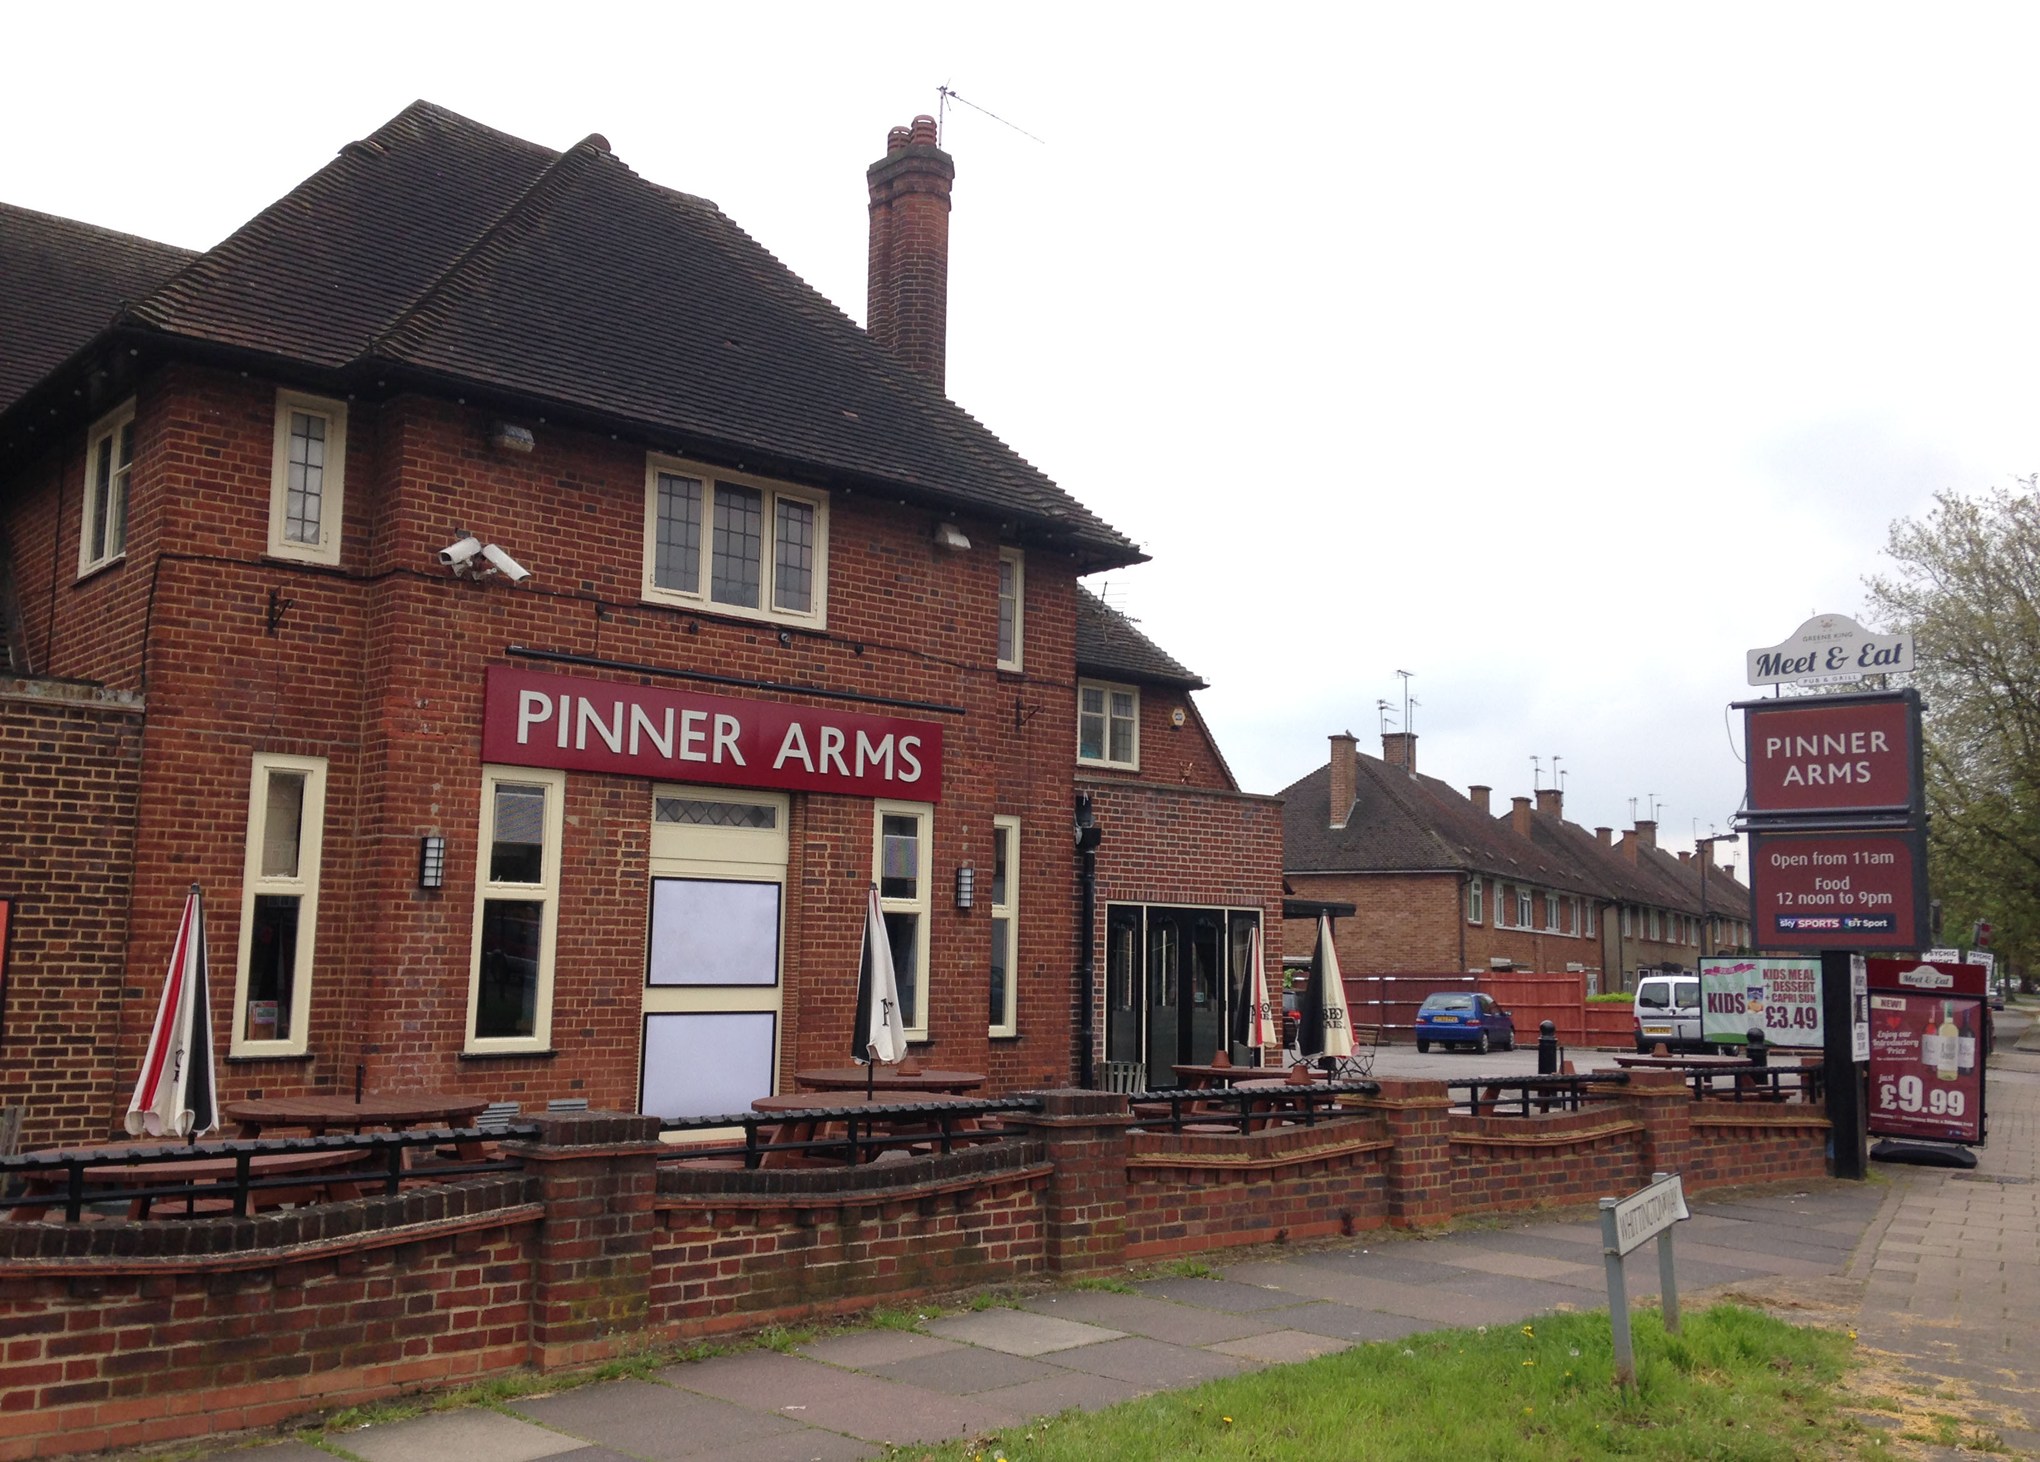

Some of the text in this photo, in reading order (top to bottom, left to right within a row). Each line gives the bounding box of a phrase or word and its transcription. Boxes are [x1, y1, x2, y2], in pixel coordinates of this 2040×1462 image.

[1834, 631, 1853, 639] KING
[1756, 642, 1903, 677] Meet & Eat
[516, 689, 923, 783] PINNER ARMS
[1766, 730, 1890, 759] PINNER
[1782, 761, 1872, 787] ARMS
[1770, 851, 1895, 869] Open from 11am
[1815, 875, 1850, 891] Food
[1776, 891, 1893, 908] 12 noon to 9pm
[1779, 918, 1796, 928] sky
[1797, 919, 1840, 928] SPORTS
[1863, 919, 1888, 928] Sport
[1763, 968, 1815, 981] KIDS MEAL
[1903, 974, 1923, 983] Meet
[1773, 981, 1816, 993] DESSERT
[1707, 992, 1746, 1015] KIDS
[1771, 993, 1796, 1003] CAPRI
[1798, 994, 1816, 1003] SUN
[1765, 1005, 1818, 1030] £3.49
[1880, 1075, 1965, 1117] £9.99
